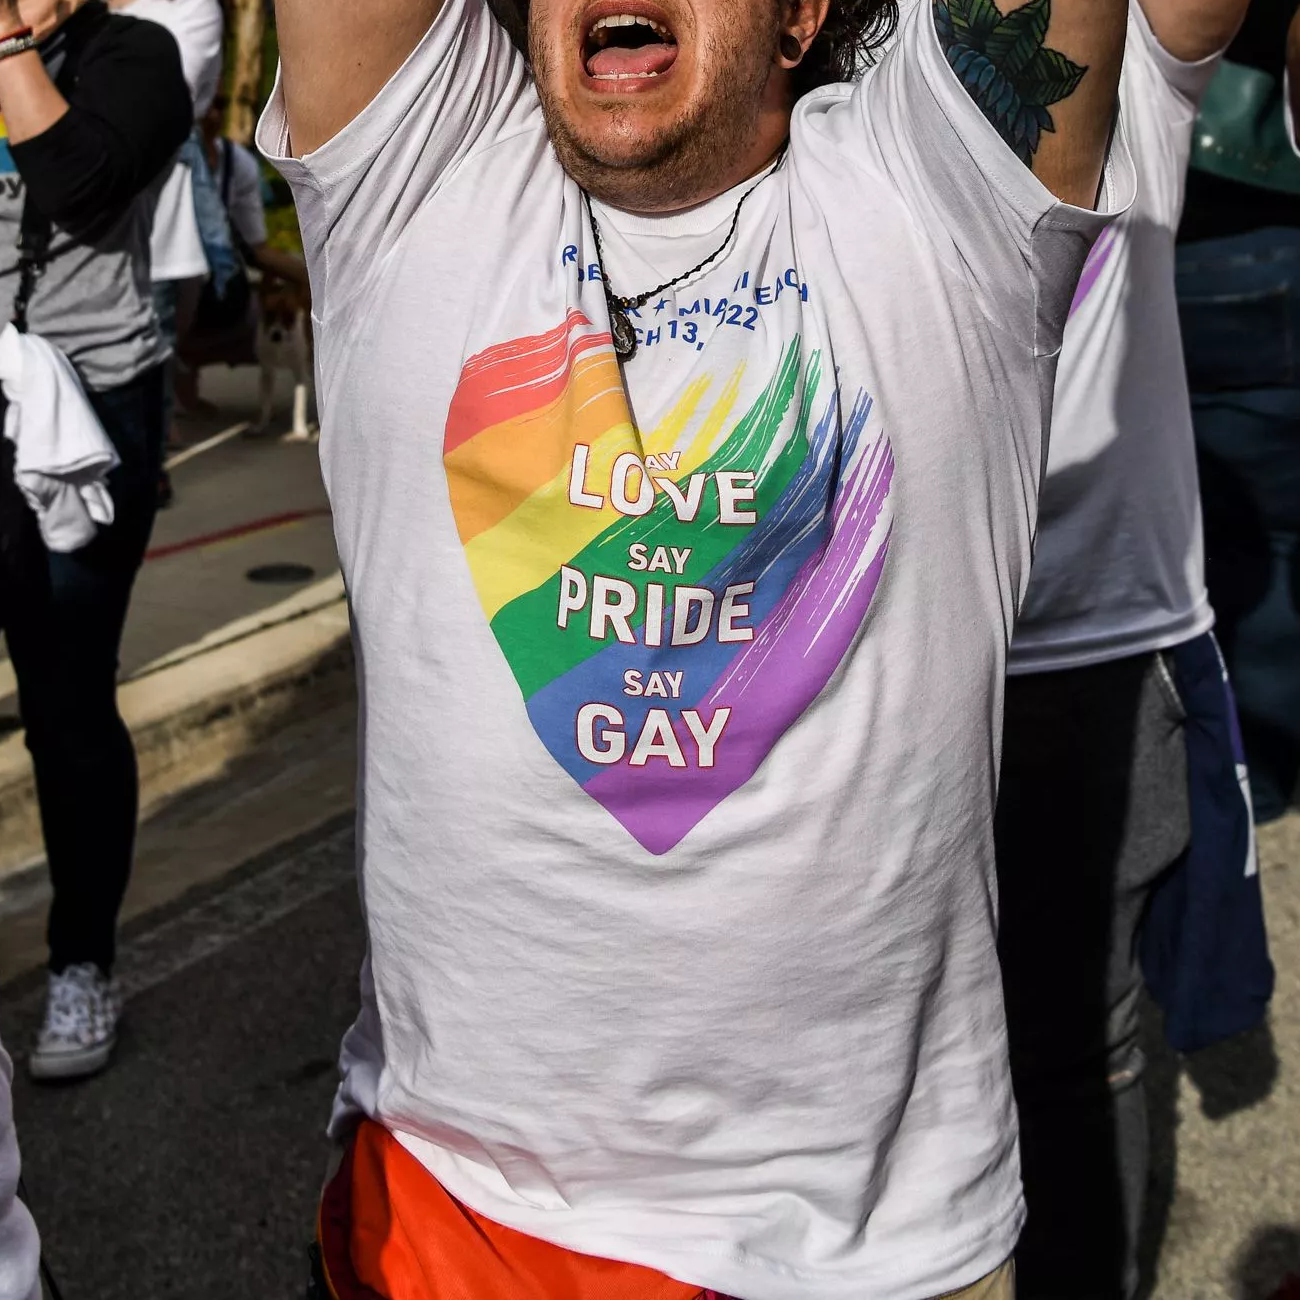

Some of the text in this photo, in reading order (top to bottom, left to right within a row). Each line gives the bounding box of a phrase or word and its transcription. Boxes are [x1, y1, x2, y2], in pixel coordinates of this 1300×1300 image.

[568, 443, 758, 525] LOVE
[645, 451, 681, 471] AY
[627, 542, 691, 575] SAY
[556, 564, 755, 647] PRIDE
[622, 668, 684, 699] SAY
[575, 702, 733, 768] GAY
